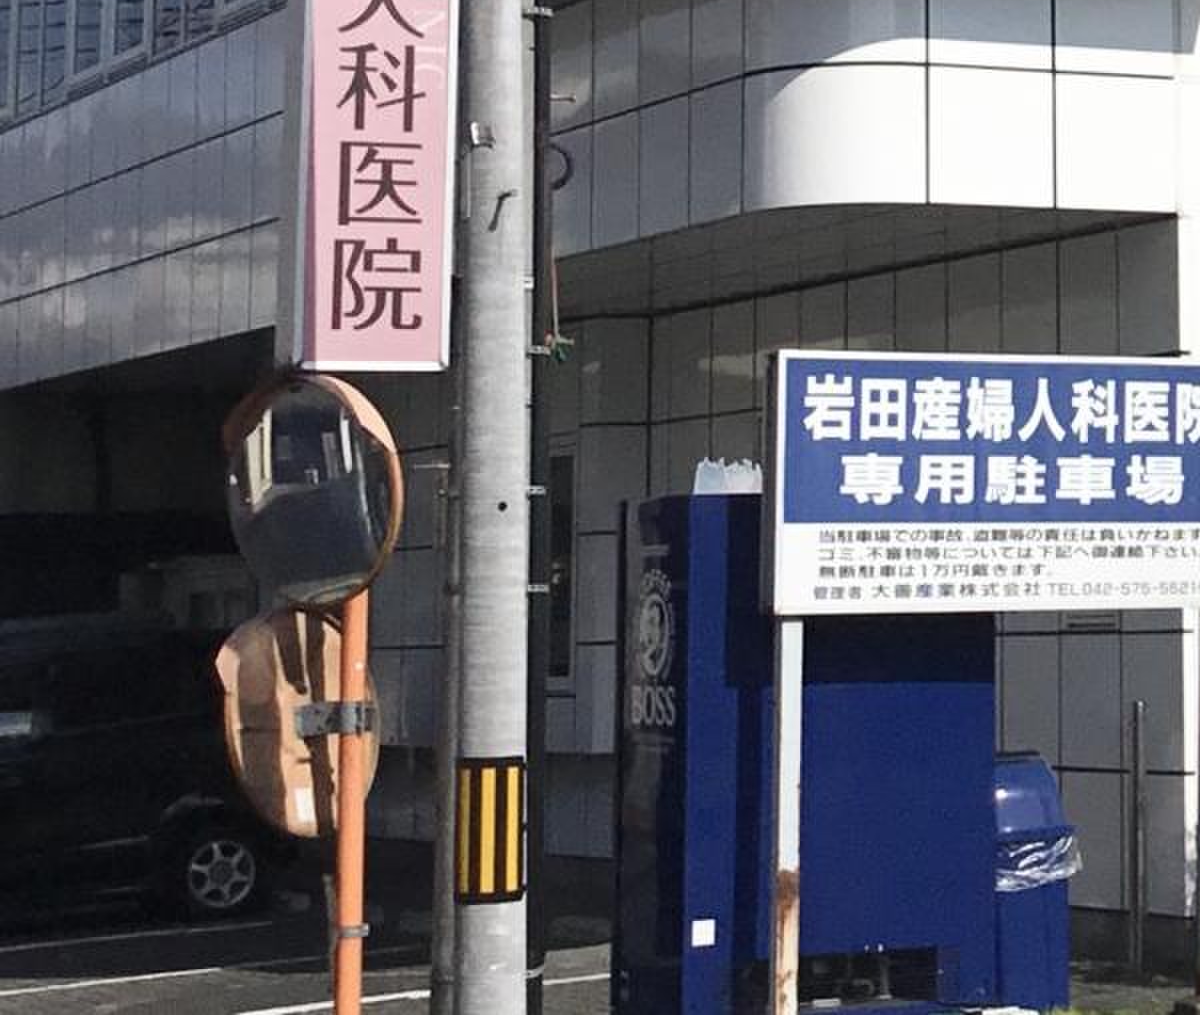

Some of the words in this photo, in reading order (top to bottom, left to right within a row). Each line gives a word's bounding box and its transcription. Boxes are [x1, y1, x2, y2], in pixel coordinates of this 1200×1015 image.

[839, 453, 1185, 506] 専用駐車場
[631, 687, 676, 726] BOSS
